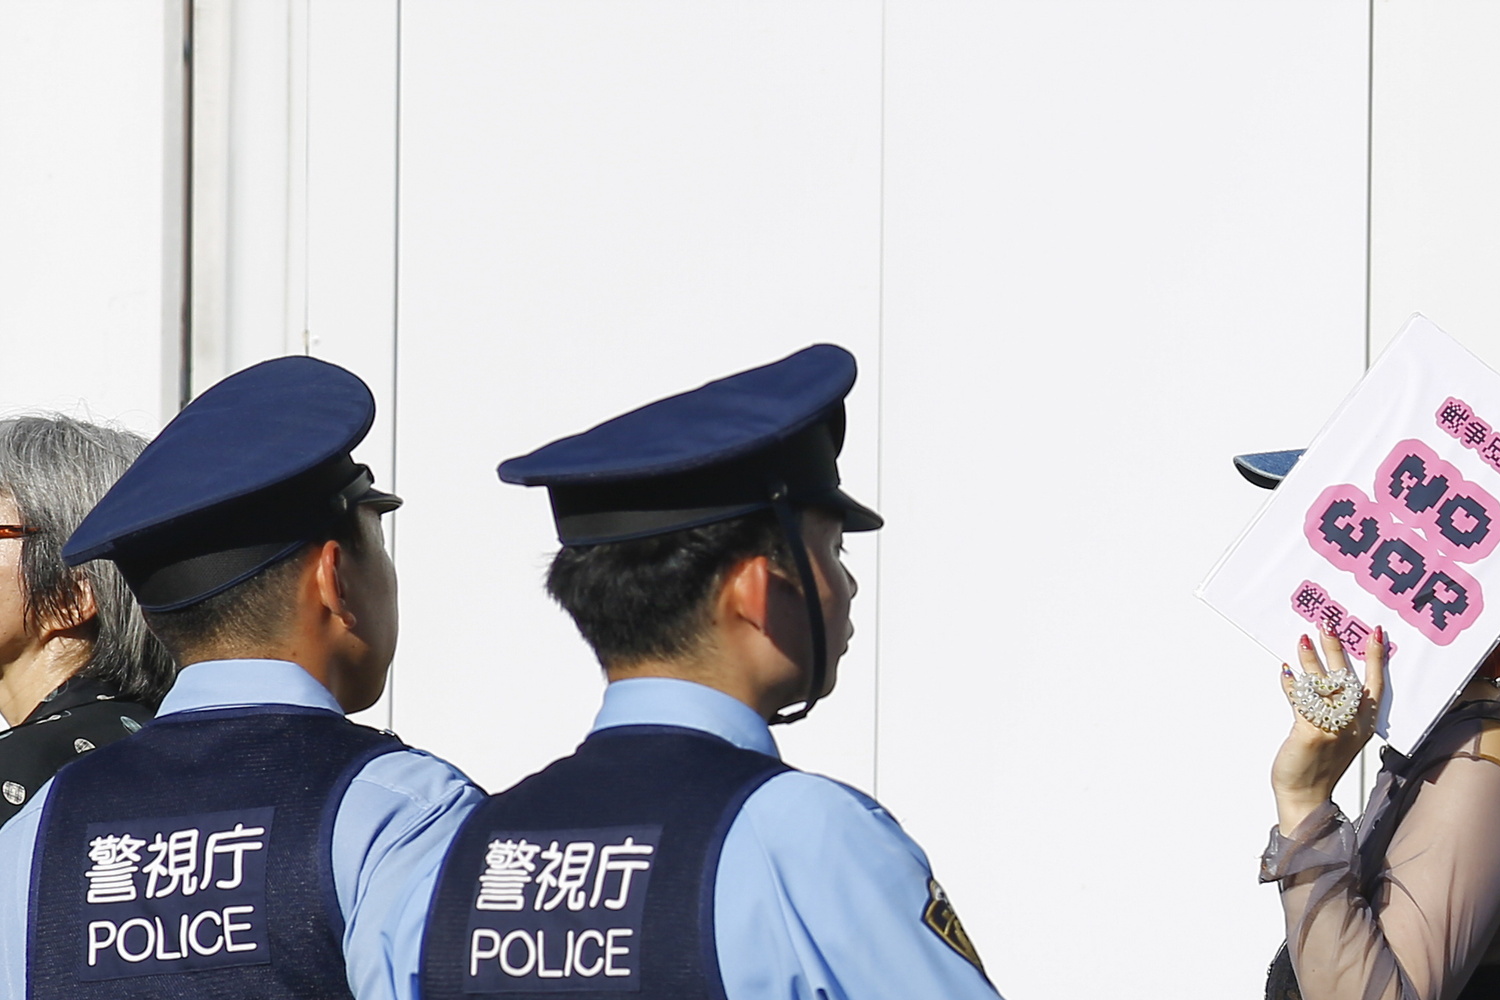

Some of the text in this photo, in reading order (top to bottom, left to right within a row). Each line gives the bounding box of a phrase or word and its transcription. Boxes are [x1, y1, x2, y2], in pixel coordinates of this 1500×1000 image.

[1389, 454, 1491, 548] NO
[1319, 500, 1468, 630] WAR
[1297, 586, 1393, 656] 戦争反
[85, 824, 264, 903] 警視庁
[477, 837, 653, 910] 警視庁
[89, 906, 256, 965] POLICE
[471, 929, 633, 977] POLICE
